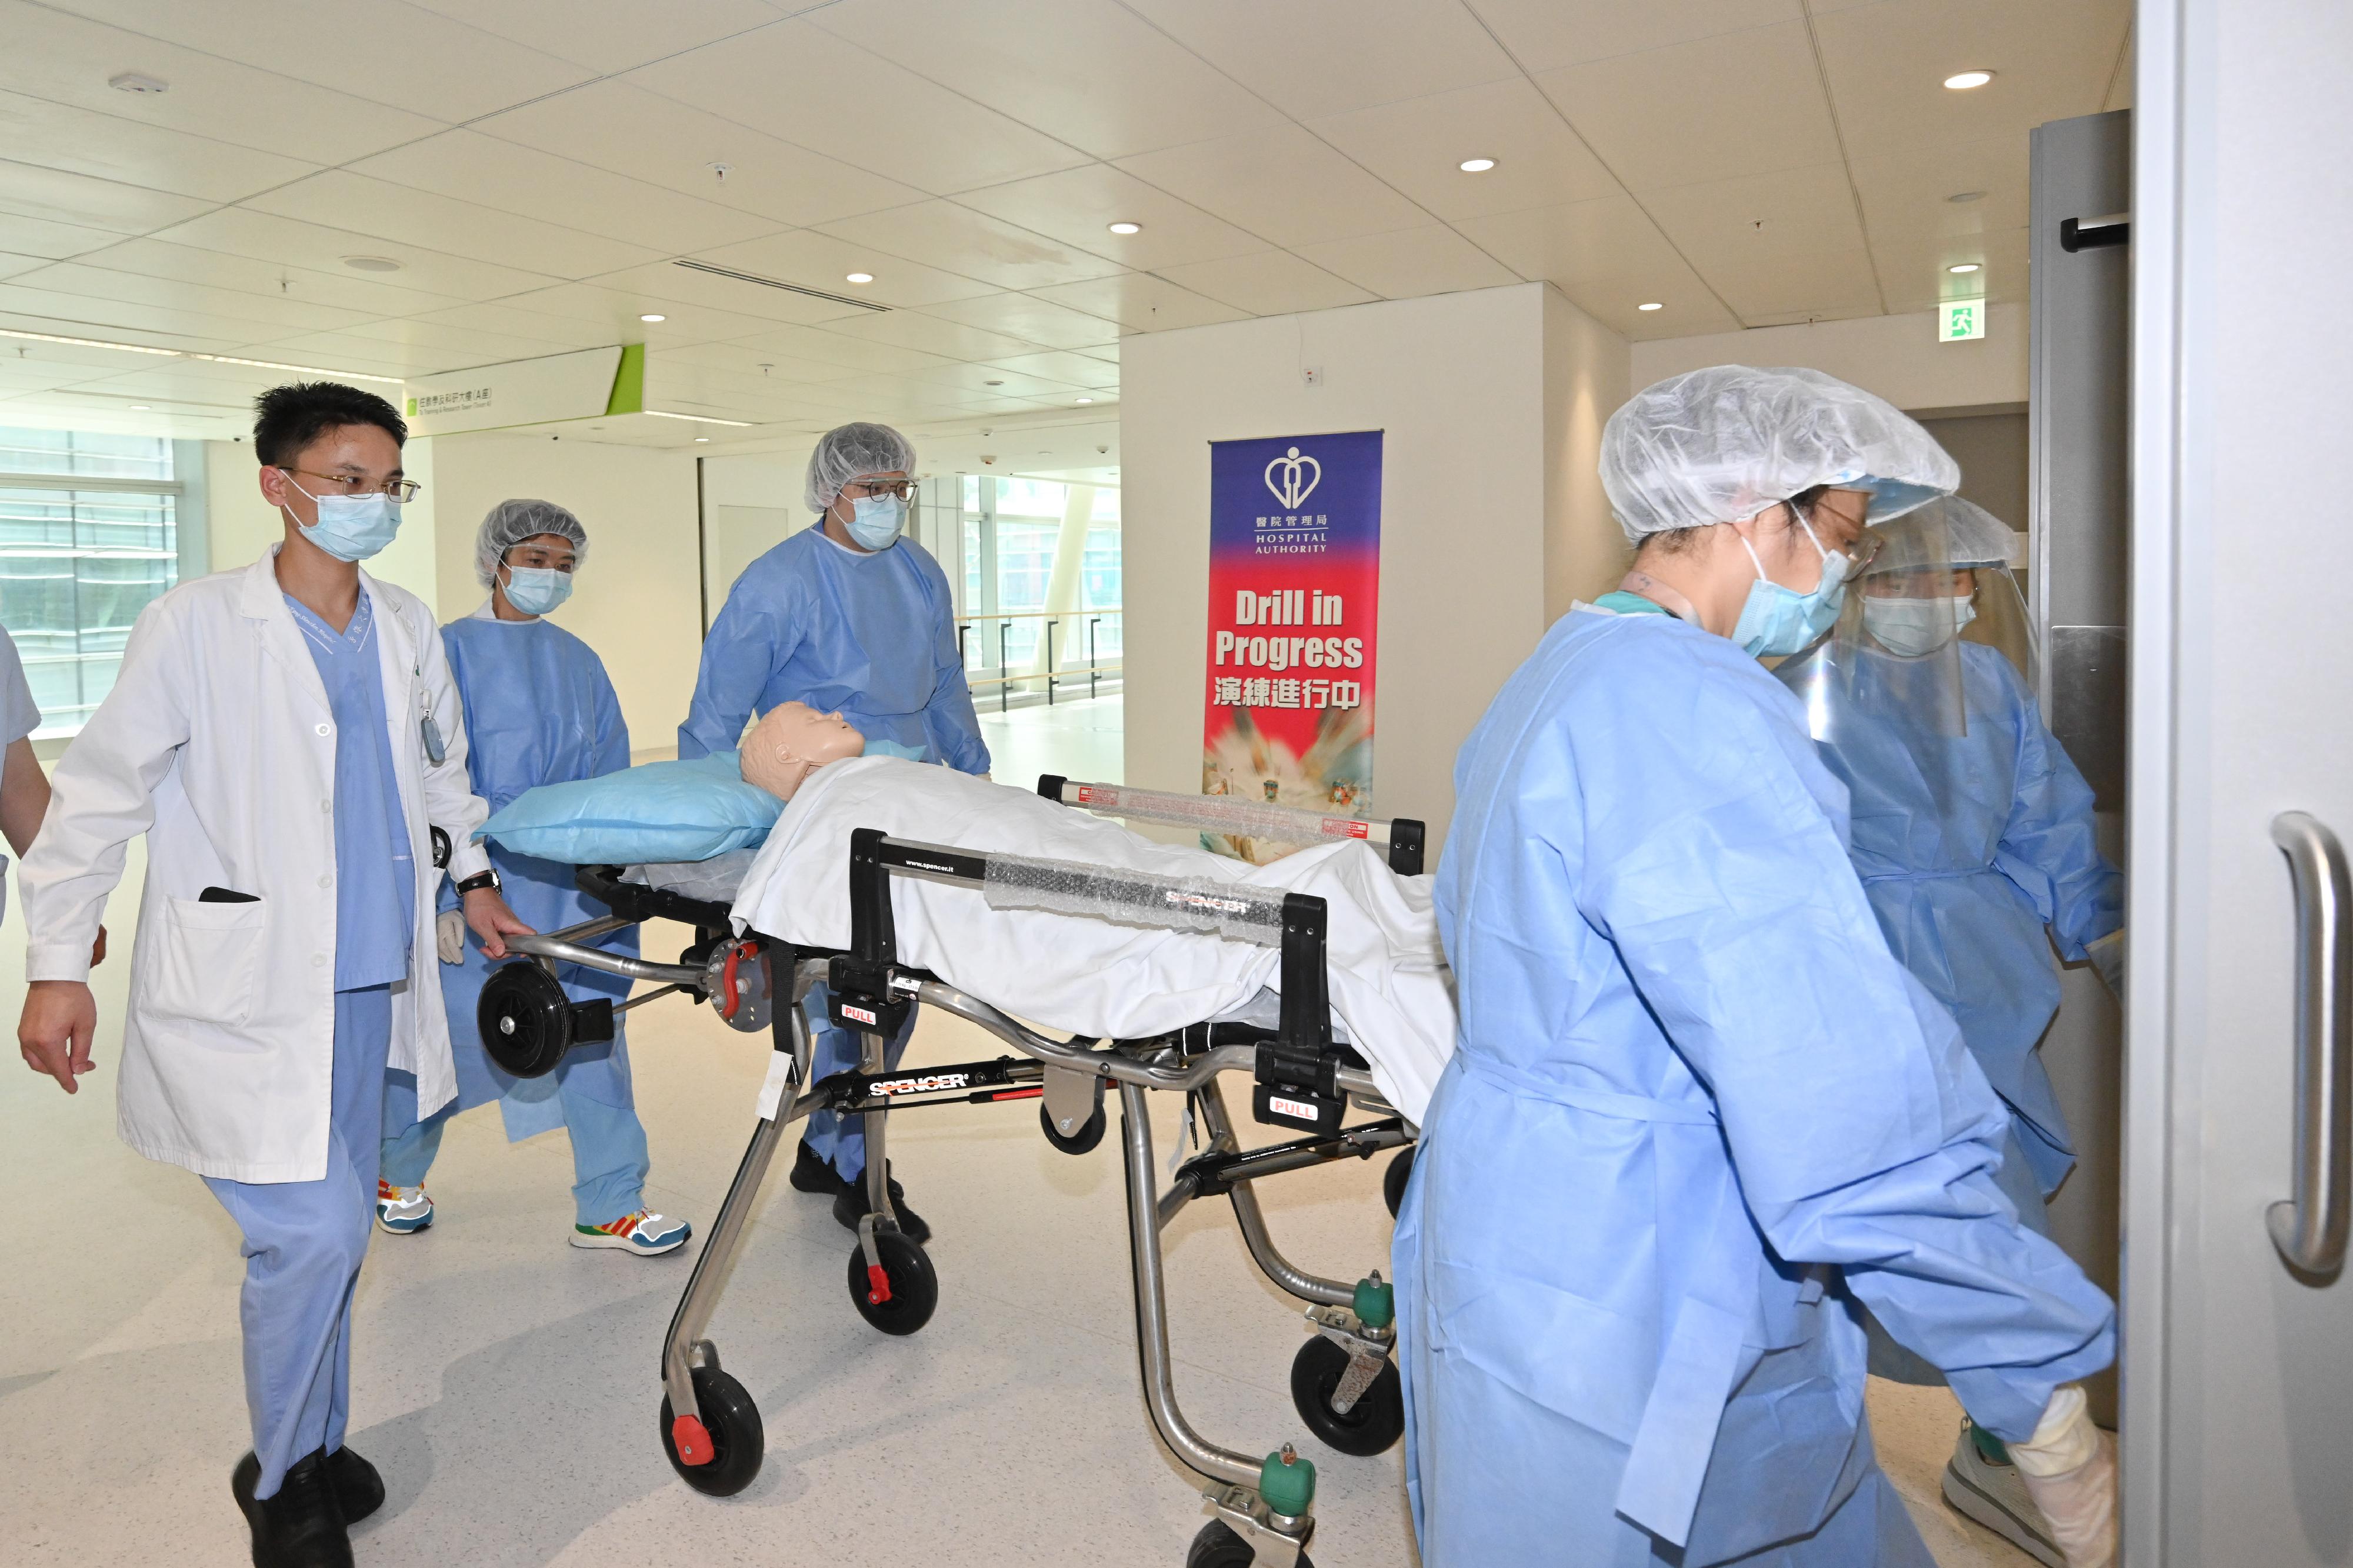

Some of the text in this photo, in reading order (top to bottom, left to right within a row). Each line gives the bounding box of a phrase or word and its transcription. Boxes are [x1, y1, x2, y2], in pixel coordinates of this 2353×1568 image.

[1256, 515, 1327, 528] 醫院管理局
[1256, 533, 1327, 543] HOSPITAL
[1255, 545, 1327, 554] AUTHORITY
[1236, 590, 1342, 625] Drill in
[1215, 630, 1363, 671] Progress
[1213, 676, 1361, 710] 演練進行中
[906, 860, 954, 873] www.spencer.it
[845, 1007, 873, 1023] PULL
[1275, 1100, 1313, 1118] PULL
